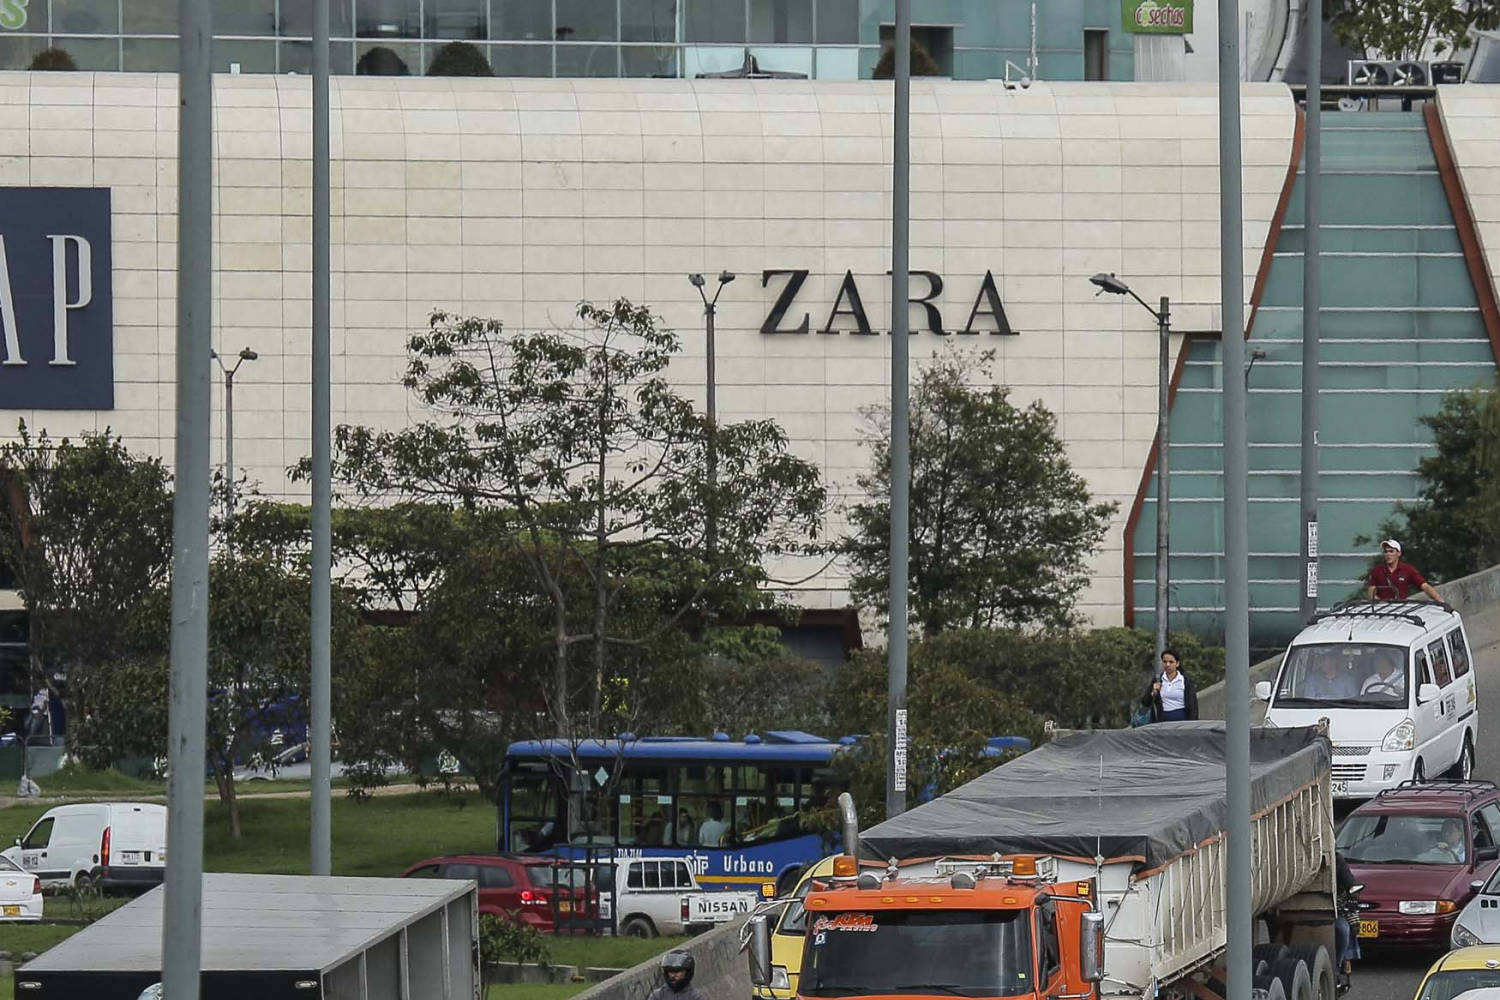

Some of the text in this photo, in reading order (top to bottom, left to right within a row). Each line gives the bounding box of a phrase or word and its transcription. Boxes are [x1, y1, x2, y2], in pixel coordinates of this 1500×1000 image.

[761, 268, 1021, 337] ZARA
[723, 855, 774, 874] Urbano
[698, 901, 749, 914] NISSAN
[1361, 923, 1378, 934] 806
